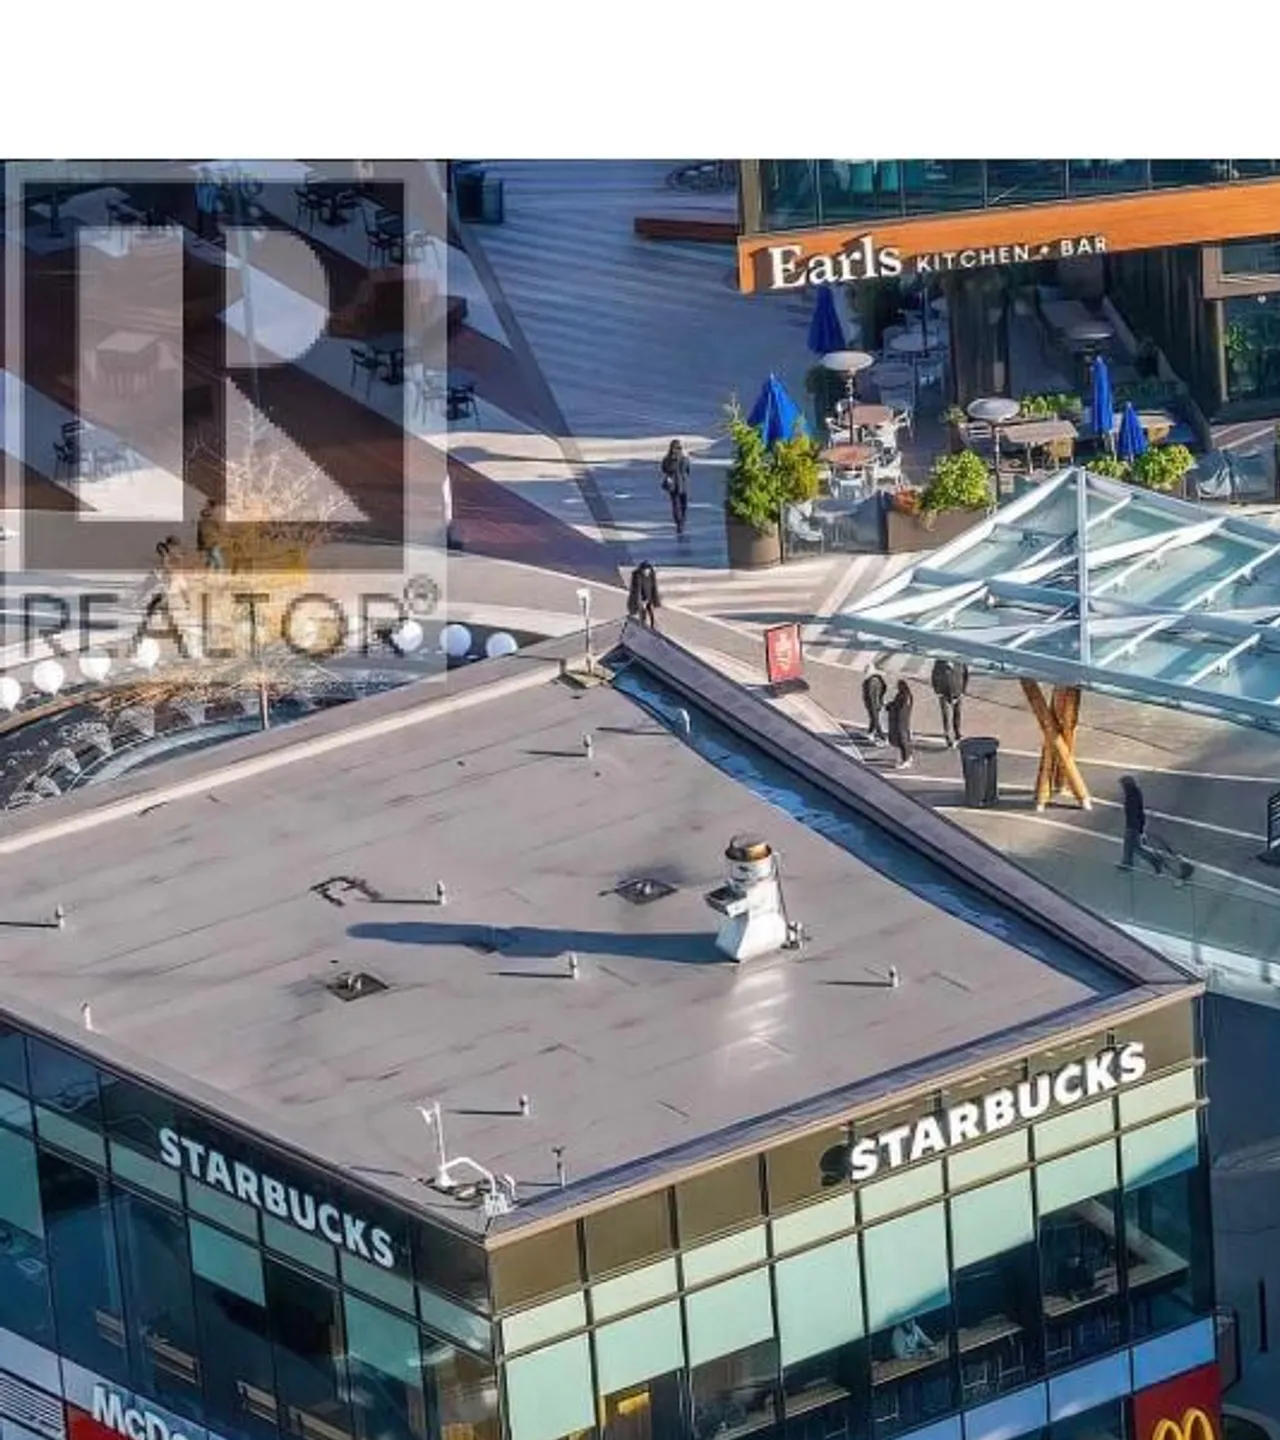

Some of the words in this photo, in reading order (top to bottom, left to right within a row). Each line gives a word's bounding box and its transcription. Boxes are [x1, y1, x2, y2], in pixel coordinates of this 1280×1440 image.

[769, 235, 901, 290] Earls
[916, 243, 1029, 273] KITCHEN
[1060, 236, 1106, 258] BAR
[849, 1041, 1147, 1181] STARBUCKS
[158, 1127, 395, 1269] STARBUCKS
